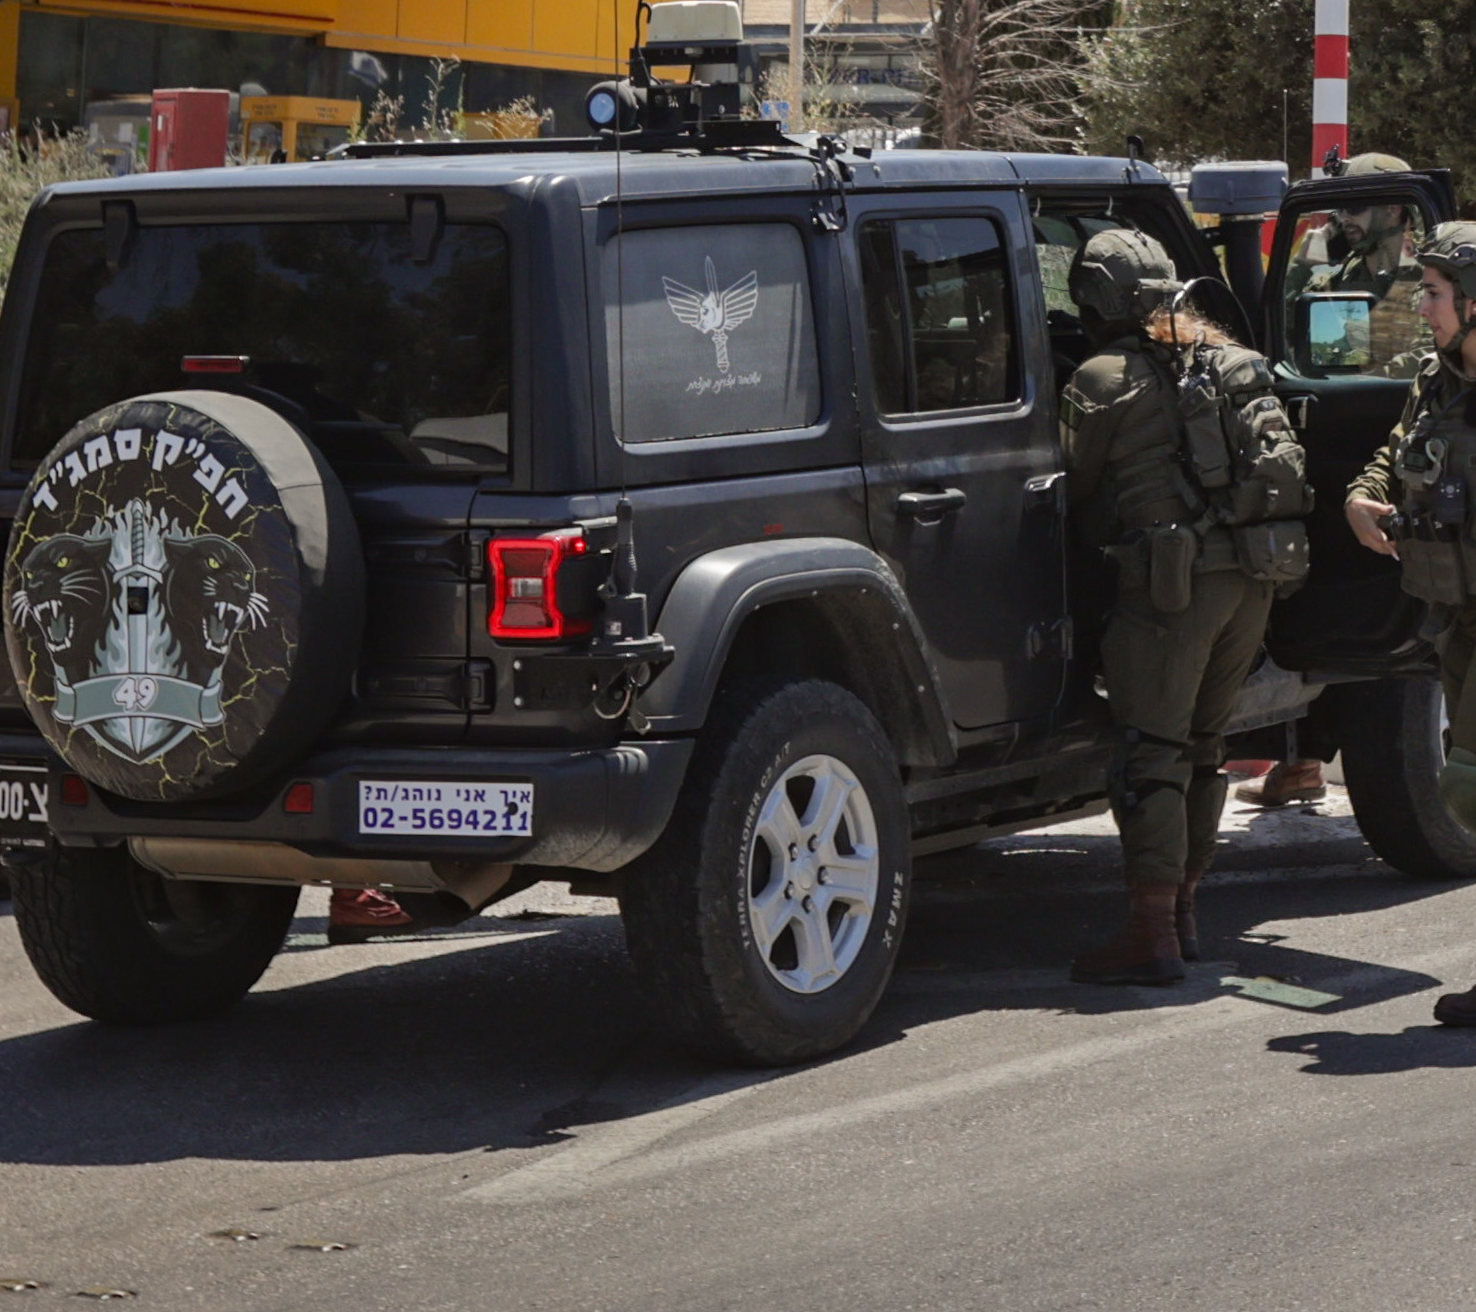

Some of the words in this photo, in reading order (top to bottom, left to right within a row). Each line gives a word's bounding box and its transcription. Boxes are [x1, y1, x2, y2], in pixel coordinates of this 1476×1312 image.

[113, 677, 158, 711] 49
[363, 785, 442, 802] נוהג/ת?
[456, 789, 486, 802] אני
[499, 790, 531, 807] איך
[363, 807, 529, 831] 02-5694211
[881, 871, 904, 950] ZMAX
